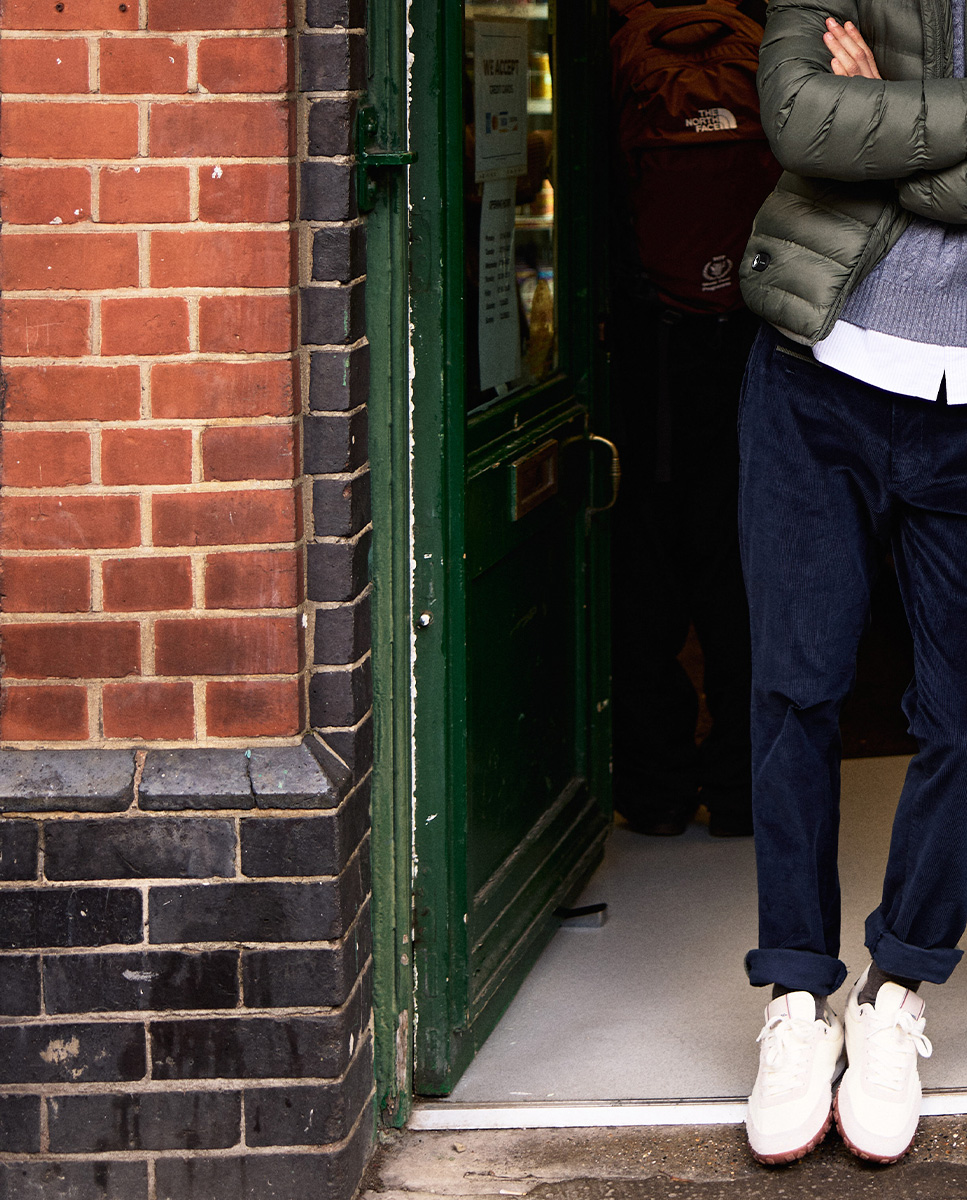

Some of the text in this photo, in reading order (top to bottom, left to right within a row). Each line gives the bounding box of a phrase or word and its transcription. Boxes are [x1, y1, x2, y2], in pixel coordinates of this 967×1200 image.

[697, 108, 718, 117] THE
[685, 115, 719, 127] NORTH
[695, 122, 721, 133] FACE
